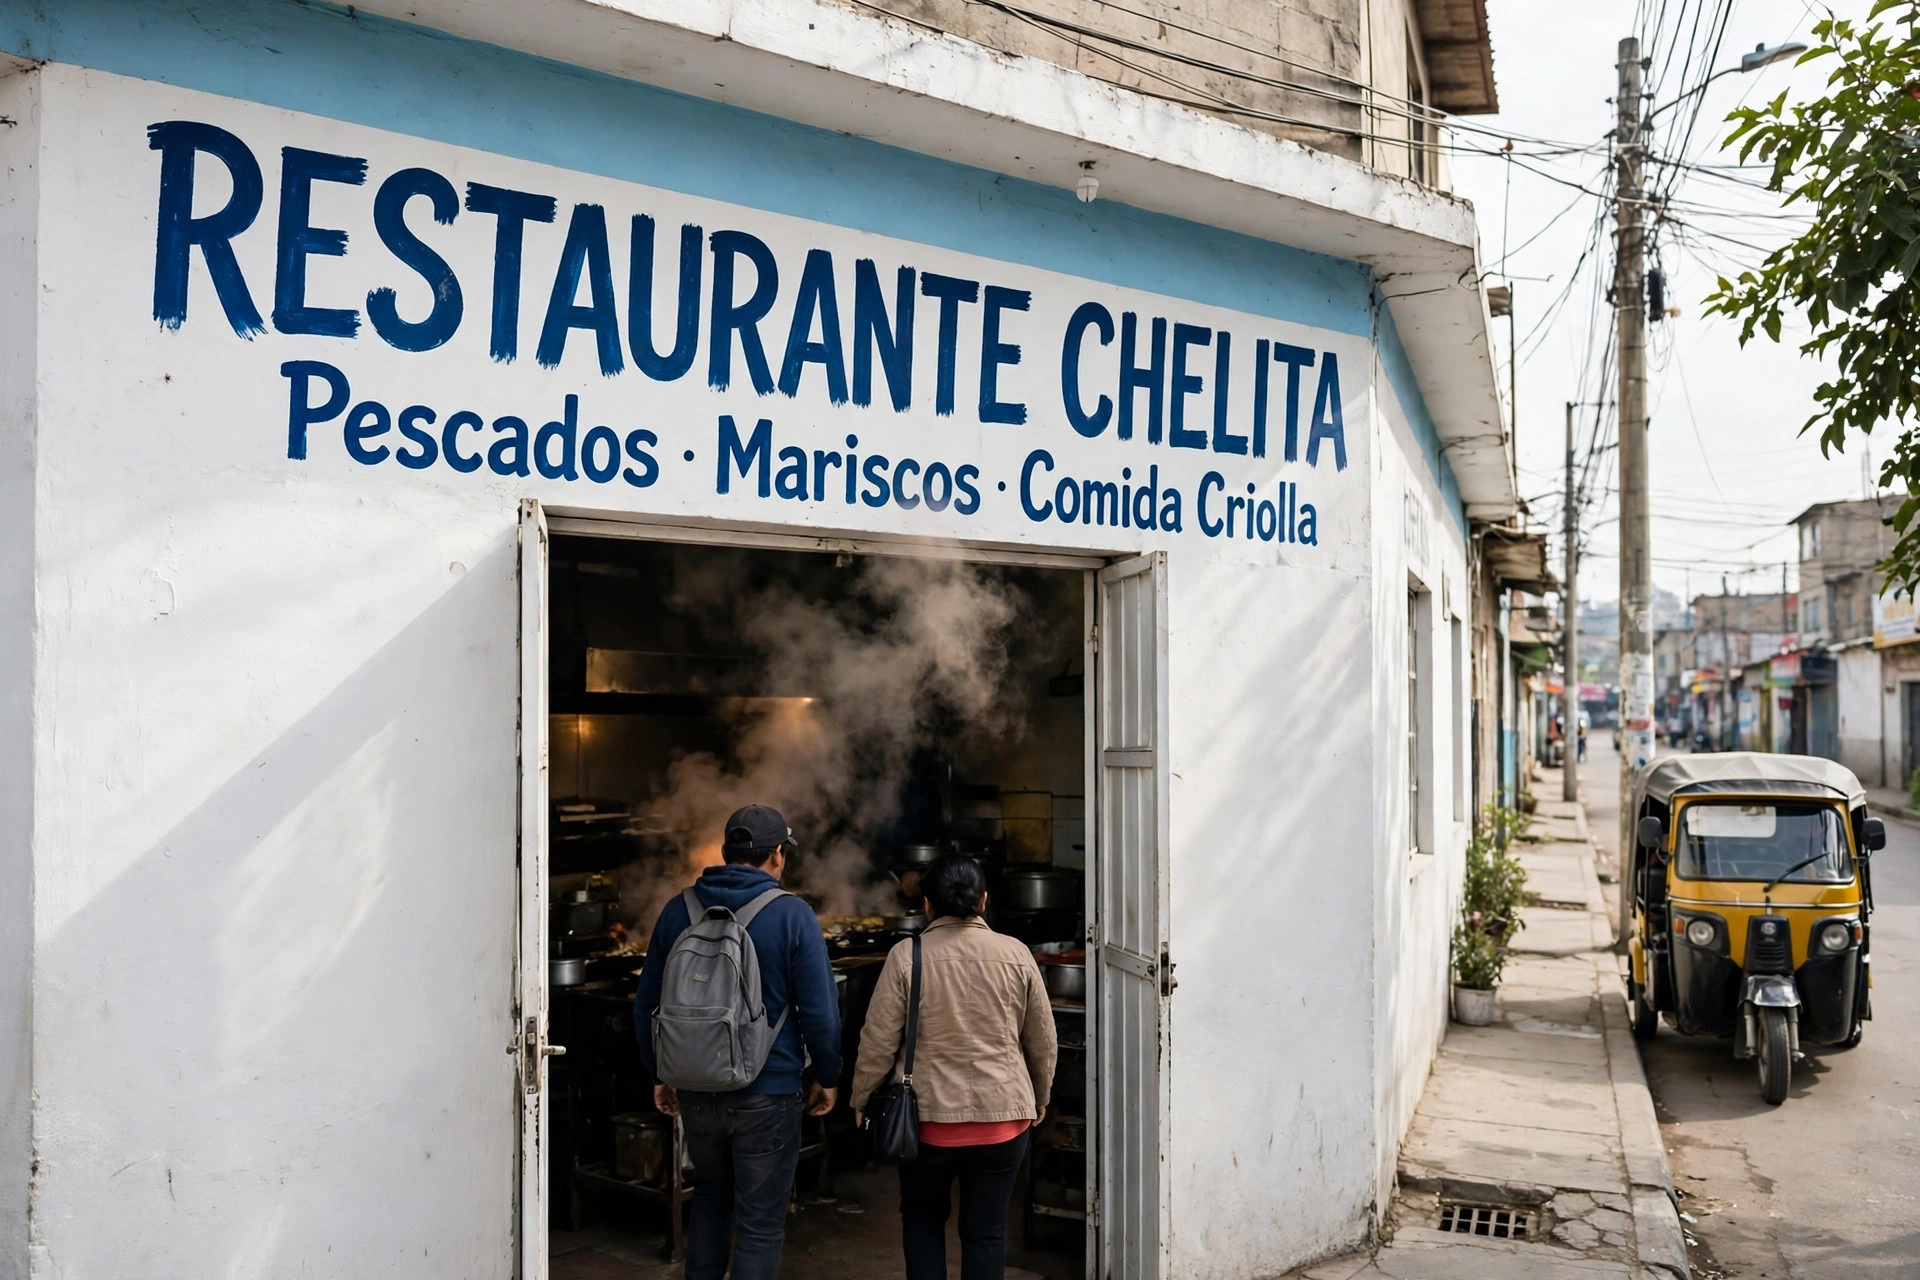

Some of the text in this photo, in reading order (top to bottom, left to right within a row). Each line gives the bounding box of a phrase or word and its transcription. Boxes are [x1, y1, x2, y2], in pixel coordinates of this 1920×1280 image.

[147, 121, 1347, 471] RESTAURANTE CHELITA
[281, 360, 659, 488] Pescados
[716, 414, 981, 516] Mariscos
[1020, 448, 1182, 534] Comida
[1197, 470, 1318, 547] Criolla
